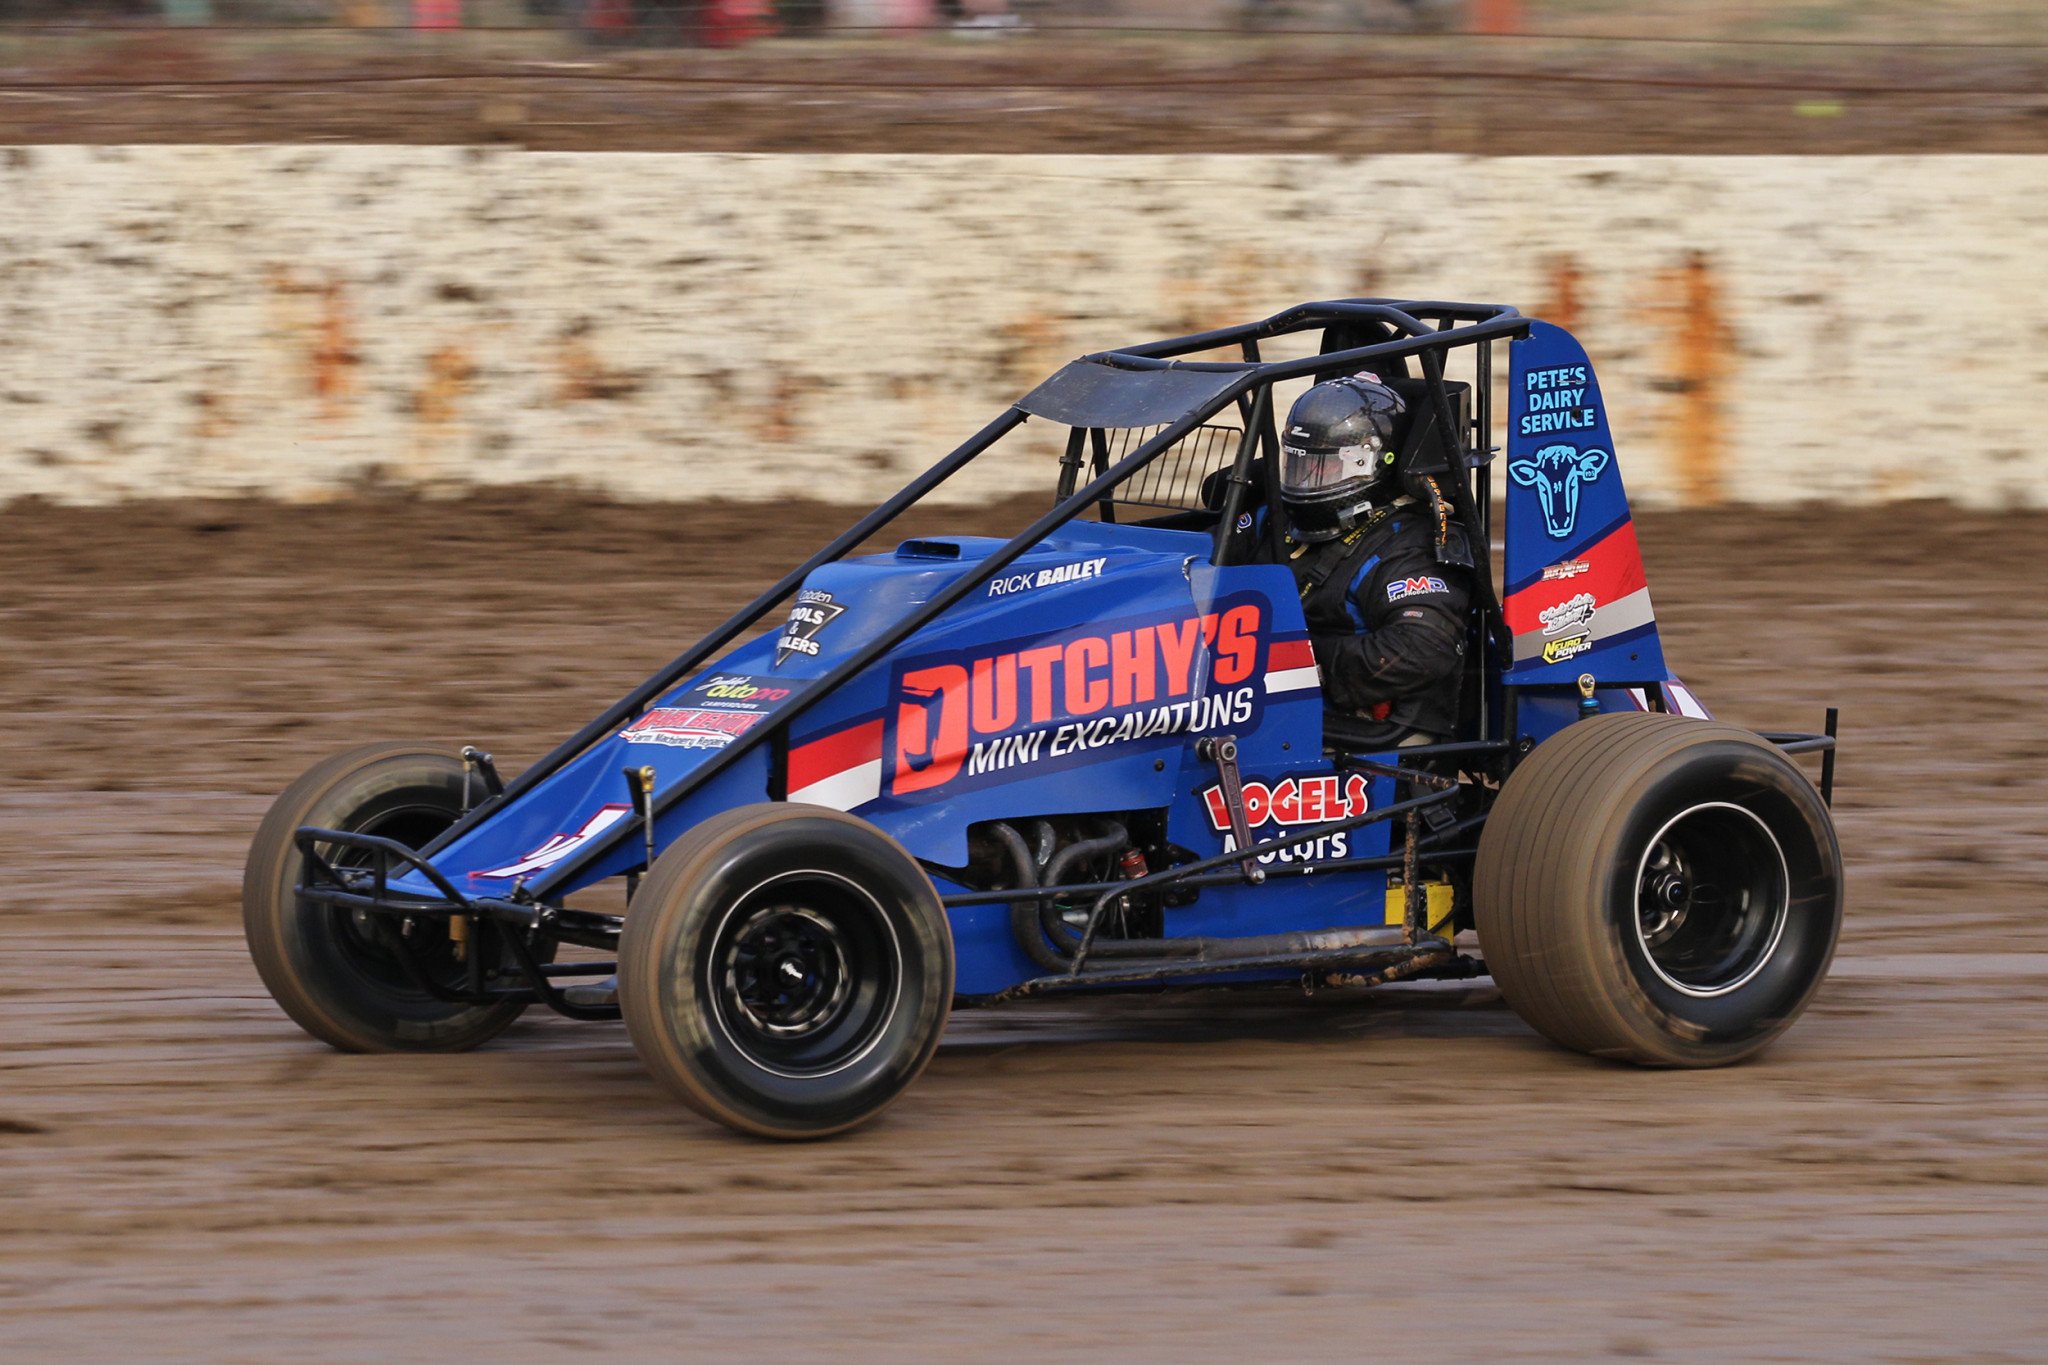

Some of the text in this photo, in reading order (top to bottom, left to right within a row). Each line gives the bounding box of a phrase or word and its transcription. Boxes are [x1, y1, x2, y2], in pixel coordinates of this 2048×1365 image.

[1527, 366, 1587, 390] PETE'S
[1529, 388, 1585, 411] DAIRY
[1521, 408, 1595, 434] SERVICE
[988, 557, 1107, 597] RICK BAILEY
[1386, 576, 1448, 598] PMD
[799, 590, 832, 602] Cobden
[788, 621, 799, 635] &
[1554, 641, 1592, 659] POWER
[892, 604, 1261, 795] DUTCHY'S
[968, 687, 1254, 776] MINI EXCAVATIONS
